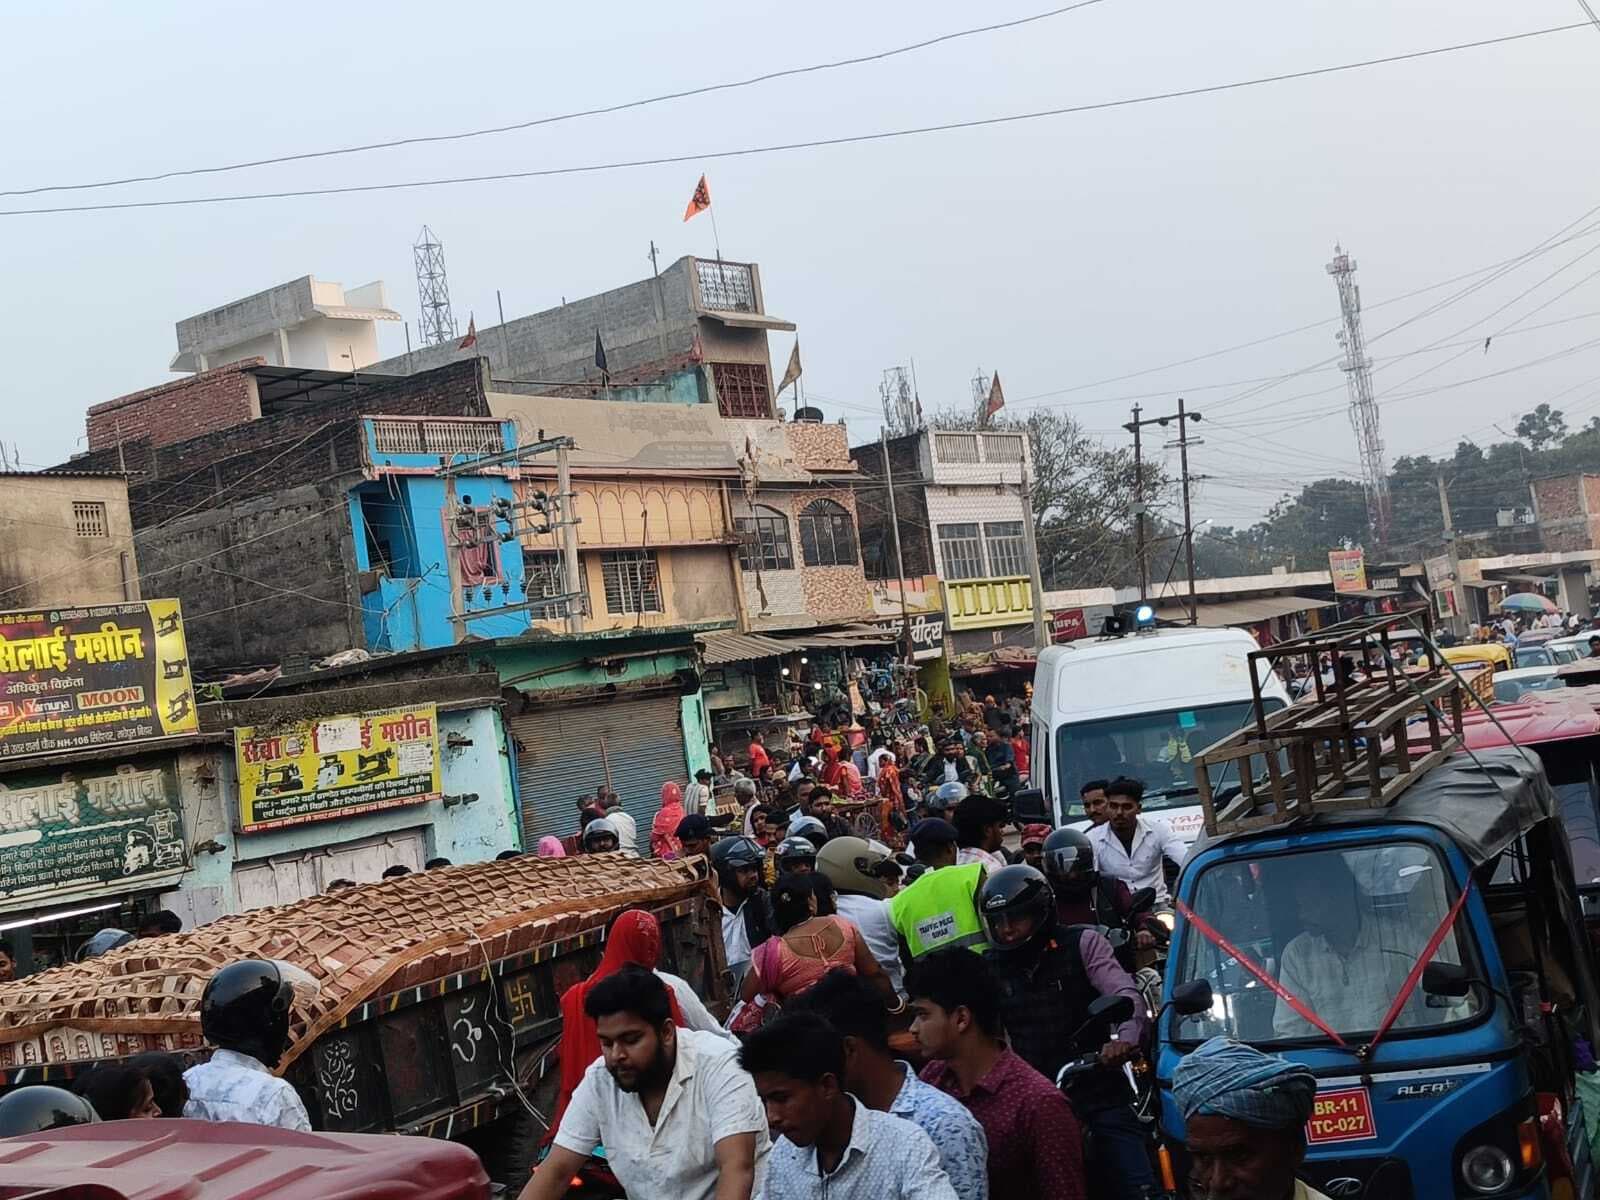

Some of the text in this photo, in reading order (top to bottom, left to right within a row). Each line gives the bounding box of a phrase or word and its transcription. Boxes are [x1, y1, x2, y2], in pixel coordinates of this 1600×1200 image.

[70, 622, 144, 664] मशीन
[6, 677, 84, 695] अधिकृत विक्रेता
[26, 697, 70, 714] Yamuna
[82, 688, 139, 708] MOON
[379, 714, 432, 742] मशीन
[82, 764, 166, 812] मशीन
[919, 921, 938, 935] TRAFFIC
[1314, 1097, 1358, 1116] BR-11
[1312, 1116, 1365, 1134] TC-027
